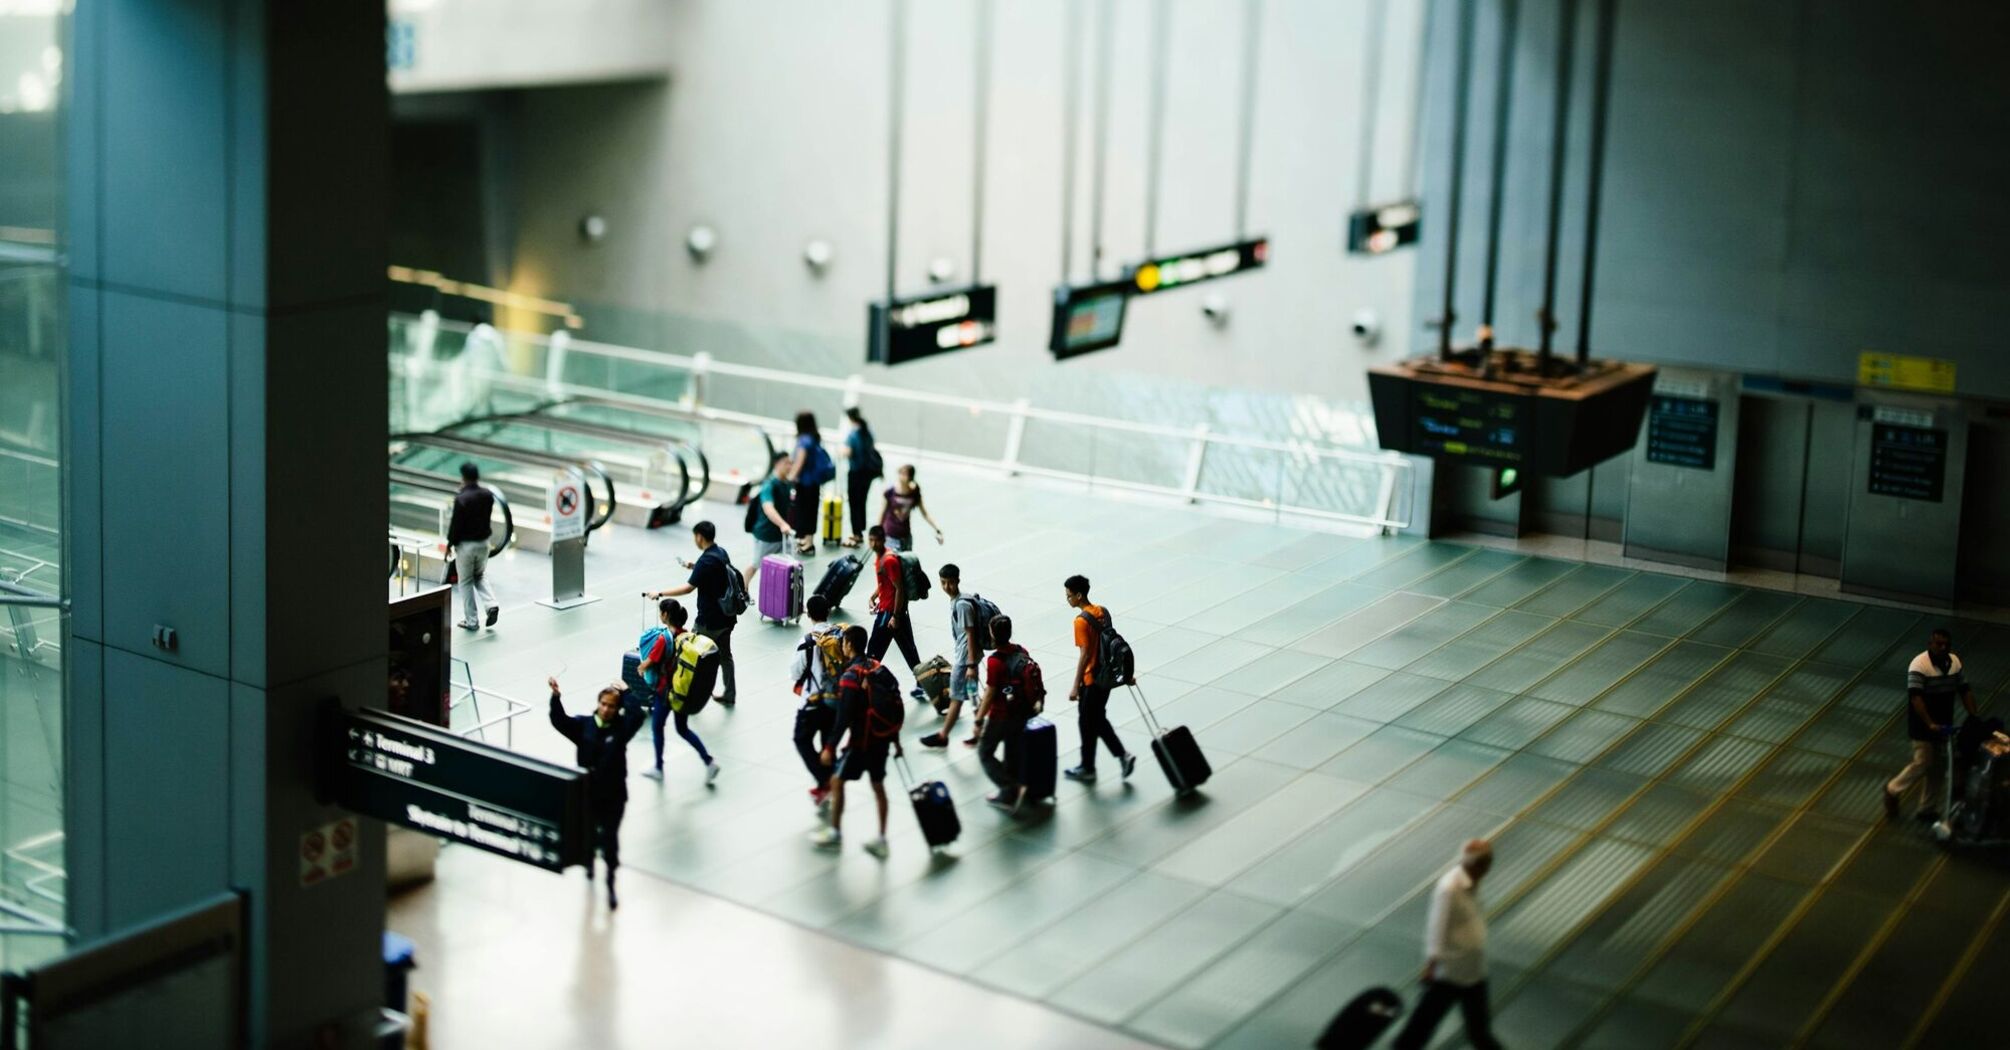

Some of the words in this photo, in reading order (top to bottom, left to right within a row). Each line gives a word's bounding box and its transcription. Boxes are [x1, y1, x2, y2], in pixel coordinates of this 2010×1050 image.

[376, 733, 424, 762] Terminal
[424, 748, 436, 765] 3
[387, 758, 414, 778] MRT
[468, 804, 519, 832] Terminal
[468, 822, 520, 854] Terminal
